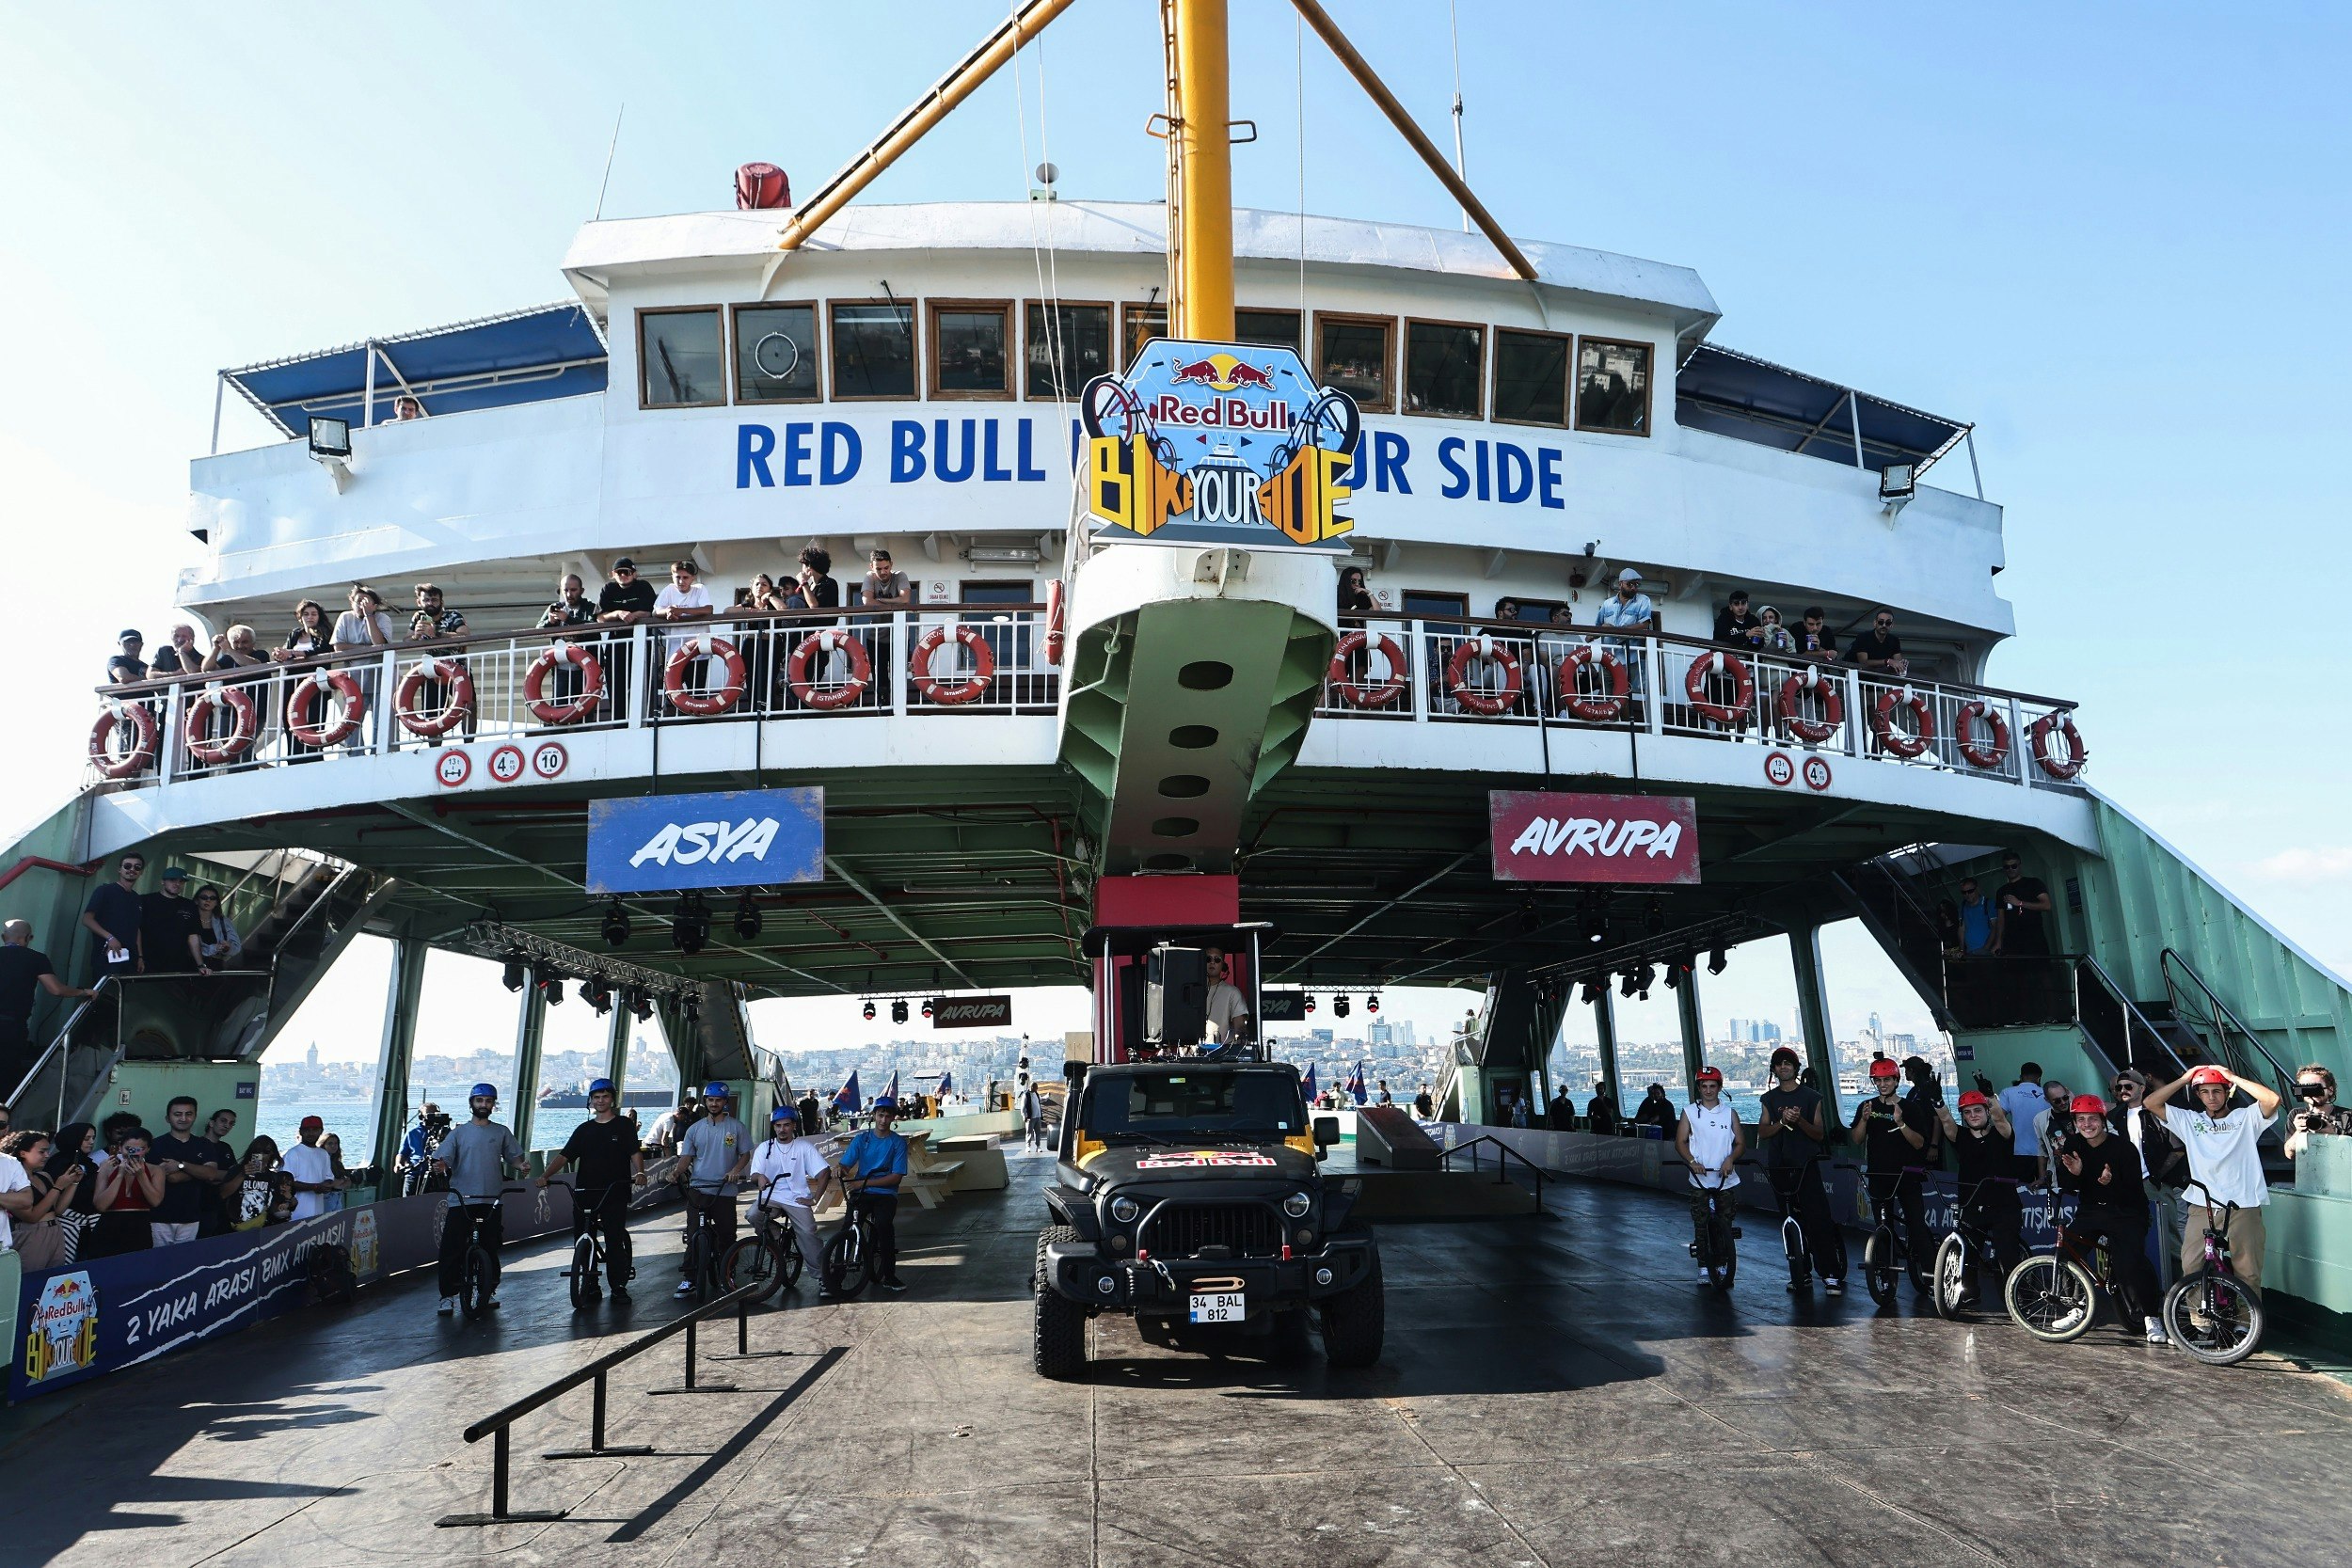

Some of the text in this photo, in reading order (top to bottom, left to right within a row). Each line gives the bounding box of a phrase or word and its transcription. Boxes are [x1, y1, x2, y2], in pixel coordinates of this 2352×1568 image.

[1160, 397, 1287, 430] Red Bull
[737, 421, 862, 488] RED
[890, 419, 1045, 483] BULL
[1438, 436, 1565, 509] SIDE
[1089, 434, 1193, 537] BIKE
[1186, 468, 1263, 525] YOUR
[1260, 444, 1354, 545] SIDE
[541, 754, 558, 768] 10
[628, 817, 780, 868] ASYA
[1510, 816, 1682, 860] AVRUPA
[940, 1004, 1005, 1020] AVRUPA
[1262, 999, 1292, 1014] SYA
[49, 1298, 84, 1320] Red Bull
[126, 1315, 140, 1345] 2
[148, 1291, 197, 1337] YAKA
[204, 1266, 256, 1310] ARASI
[262, 1248, 290, 1283] BMX
[1192, 1295, 1242, 1308] 34 BAL
[1208, 1308, 1228, 1320] 812
